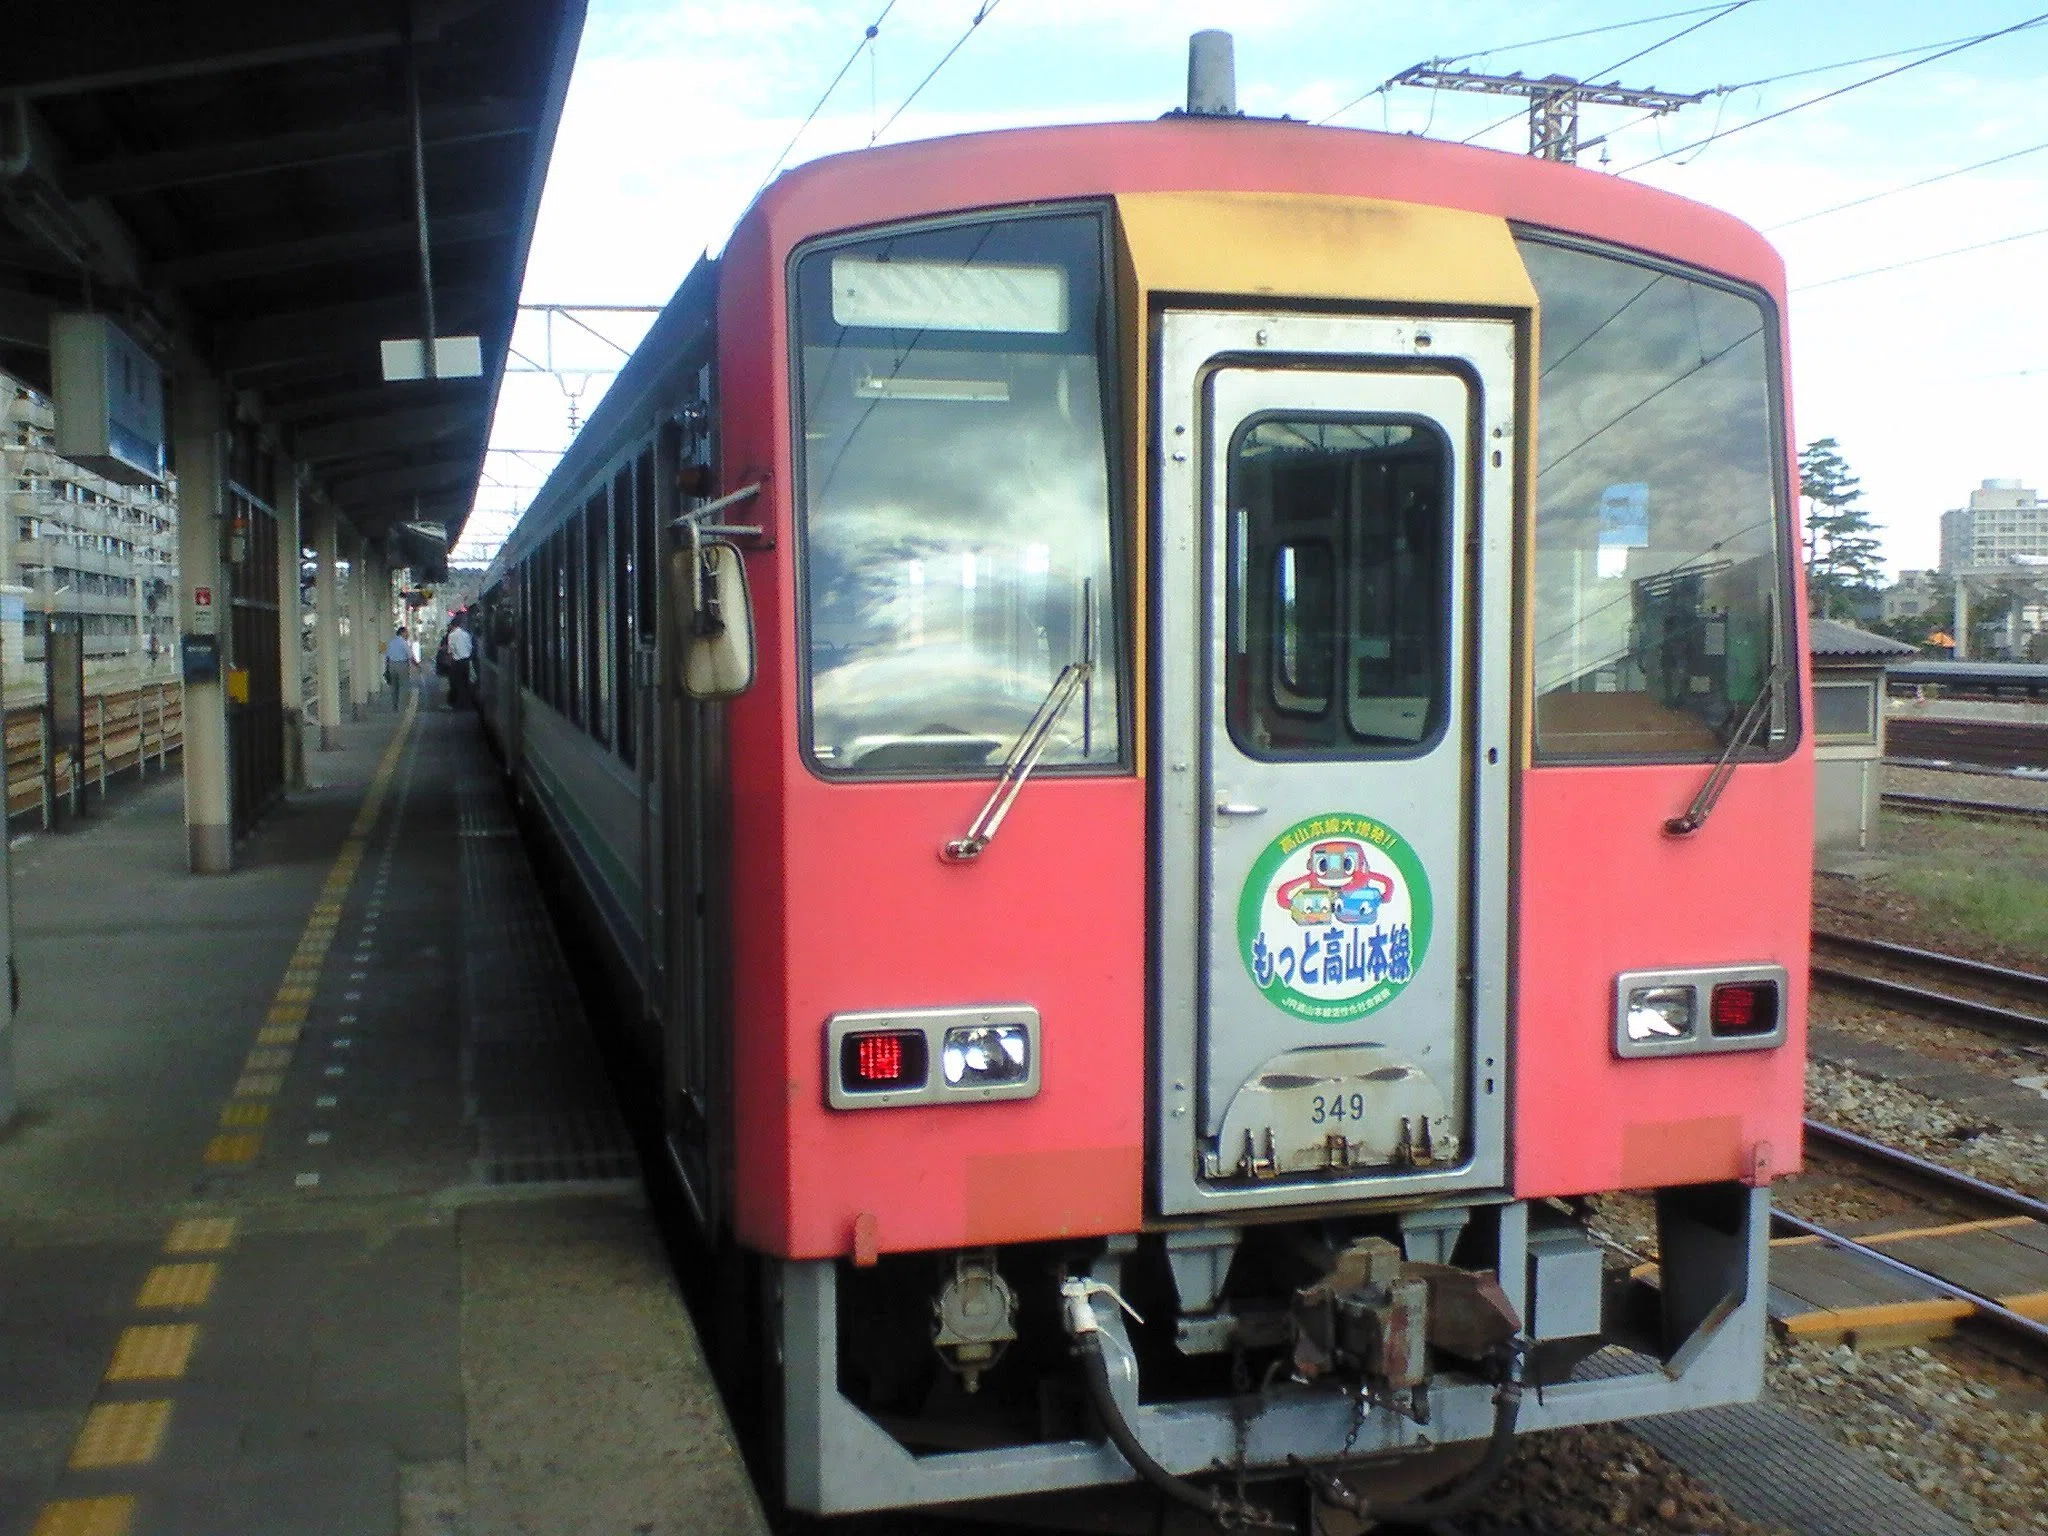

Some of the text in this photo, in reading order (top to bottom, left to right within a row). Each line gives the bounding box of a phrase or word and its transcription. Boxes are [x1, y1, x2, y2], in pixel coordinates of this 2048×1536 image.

[1253, 924, 1410, 985] もっと高山本線
[1311, 1093, 1364, 1124] 349
